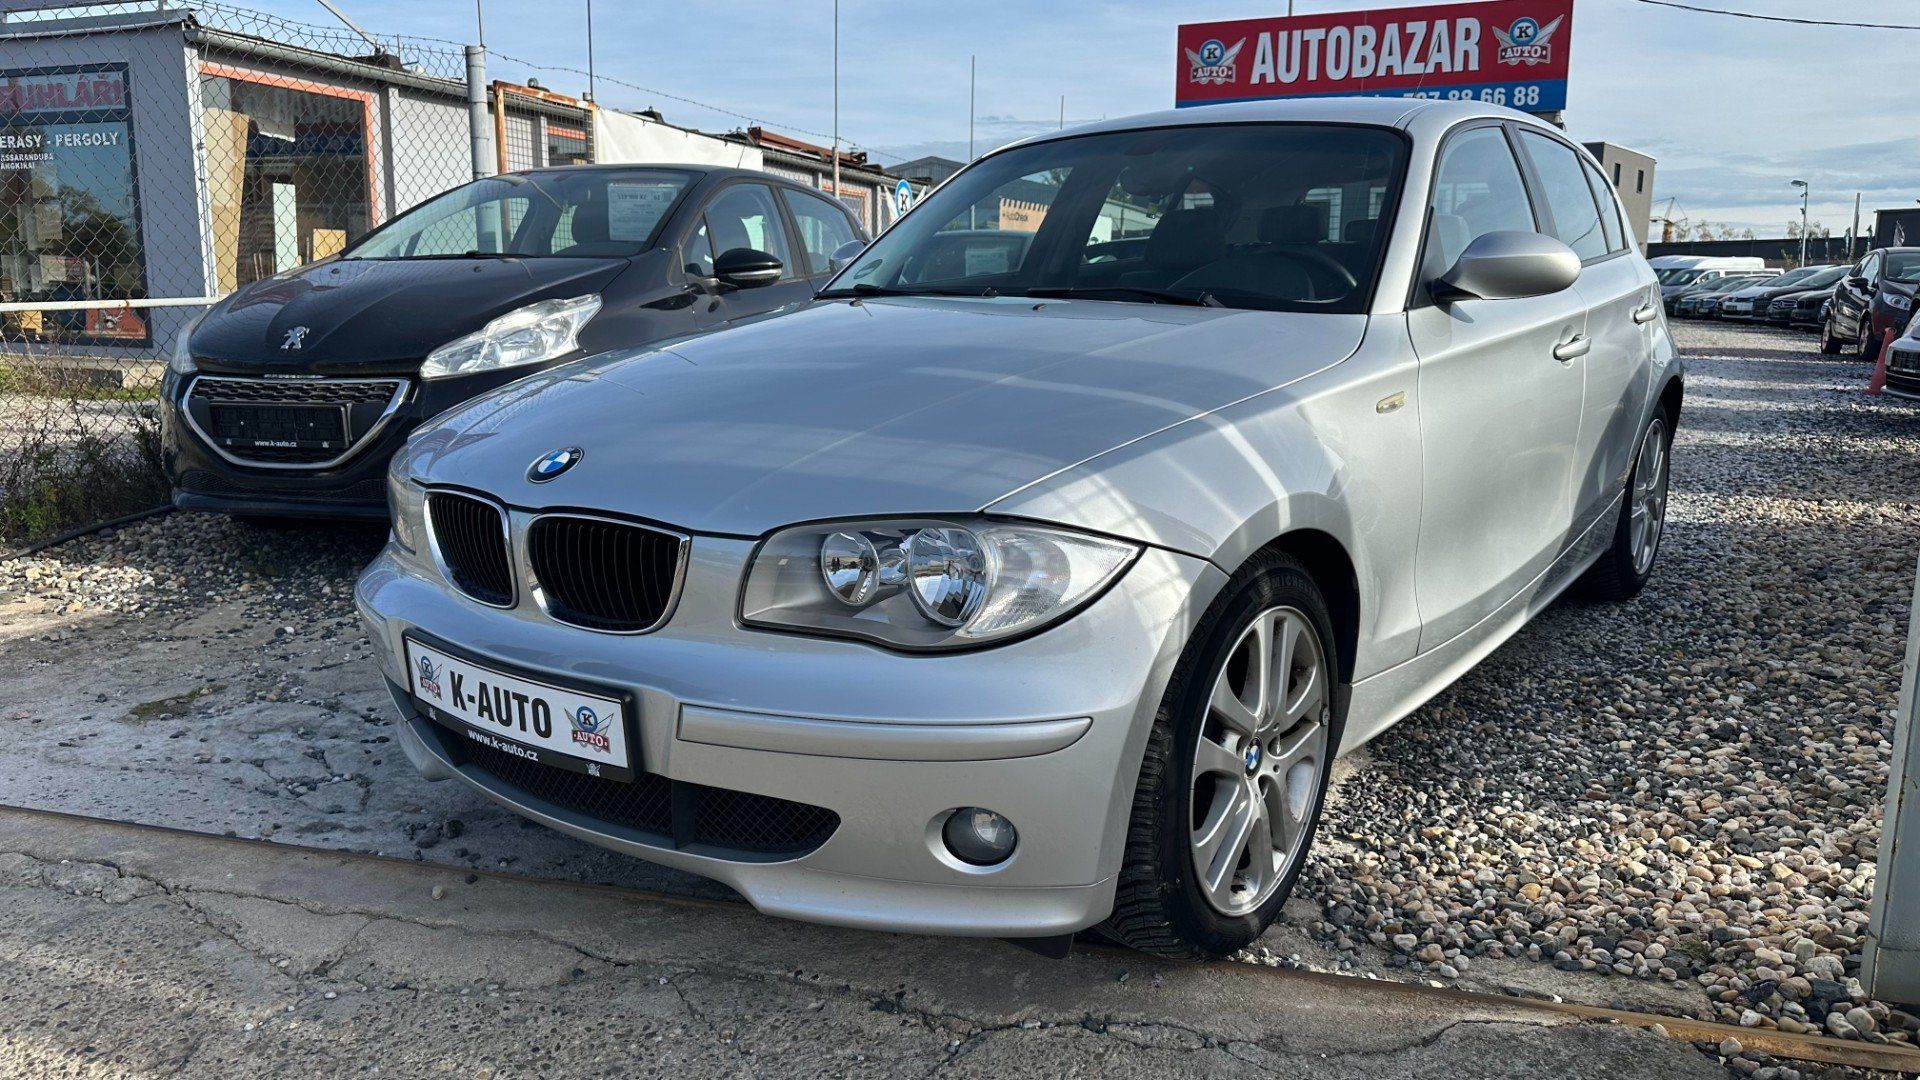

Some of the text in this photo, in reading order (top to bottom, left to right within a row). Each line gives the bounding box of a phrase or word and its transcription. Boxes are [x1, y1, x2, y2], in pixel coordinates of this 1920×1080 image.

[1516, 26, 1531, 39] K
[1206, 47, 1219, 60] K
[1250, 17, 1481, 84] AUTOBAZAR
[1505, 45, 1541, 58] AUTO
[1196, 65, 1228, 78] AUTO
[1480, 87, 1506, 106] 66
[1513, 85, 1540, 107] 88
[55, 131, 119, 147] PERGOLY
[900, 193, 908, 212] K
[450, 670, 552, 738] K-AUTO
[581, 712, 594, 727] K
[467, 728, 539, 762] www.k-auto.cz
[576, 730, 604, 748] AUTO
